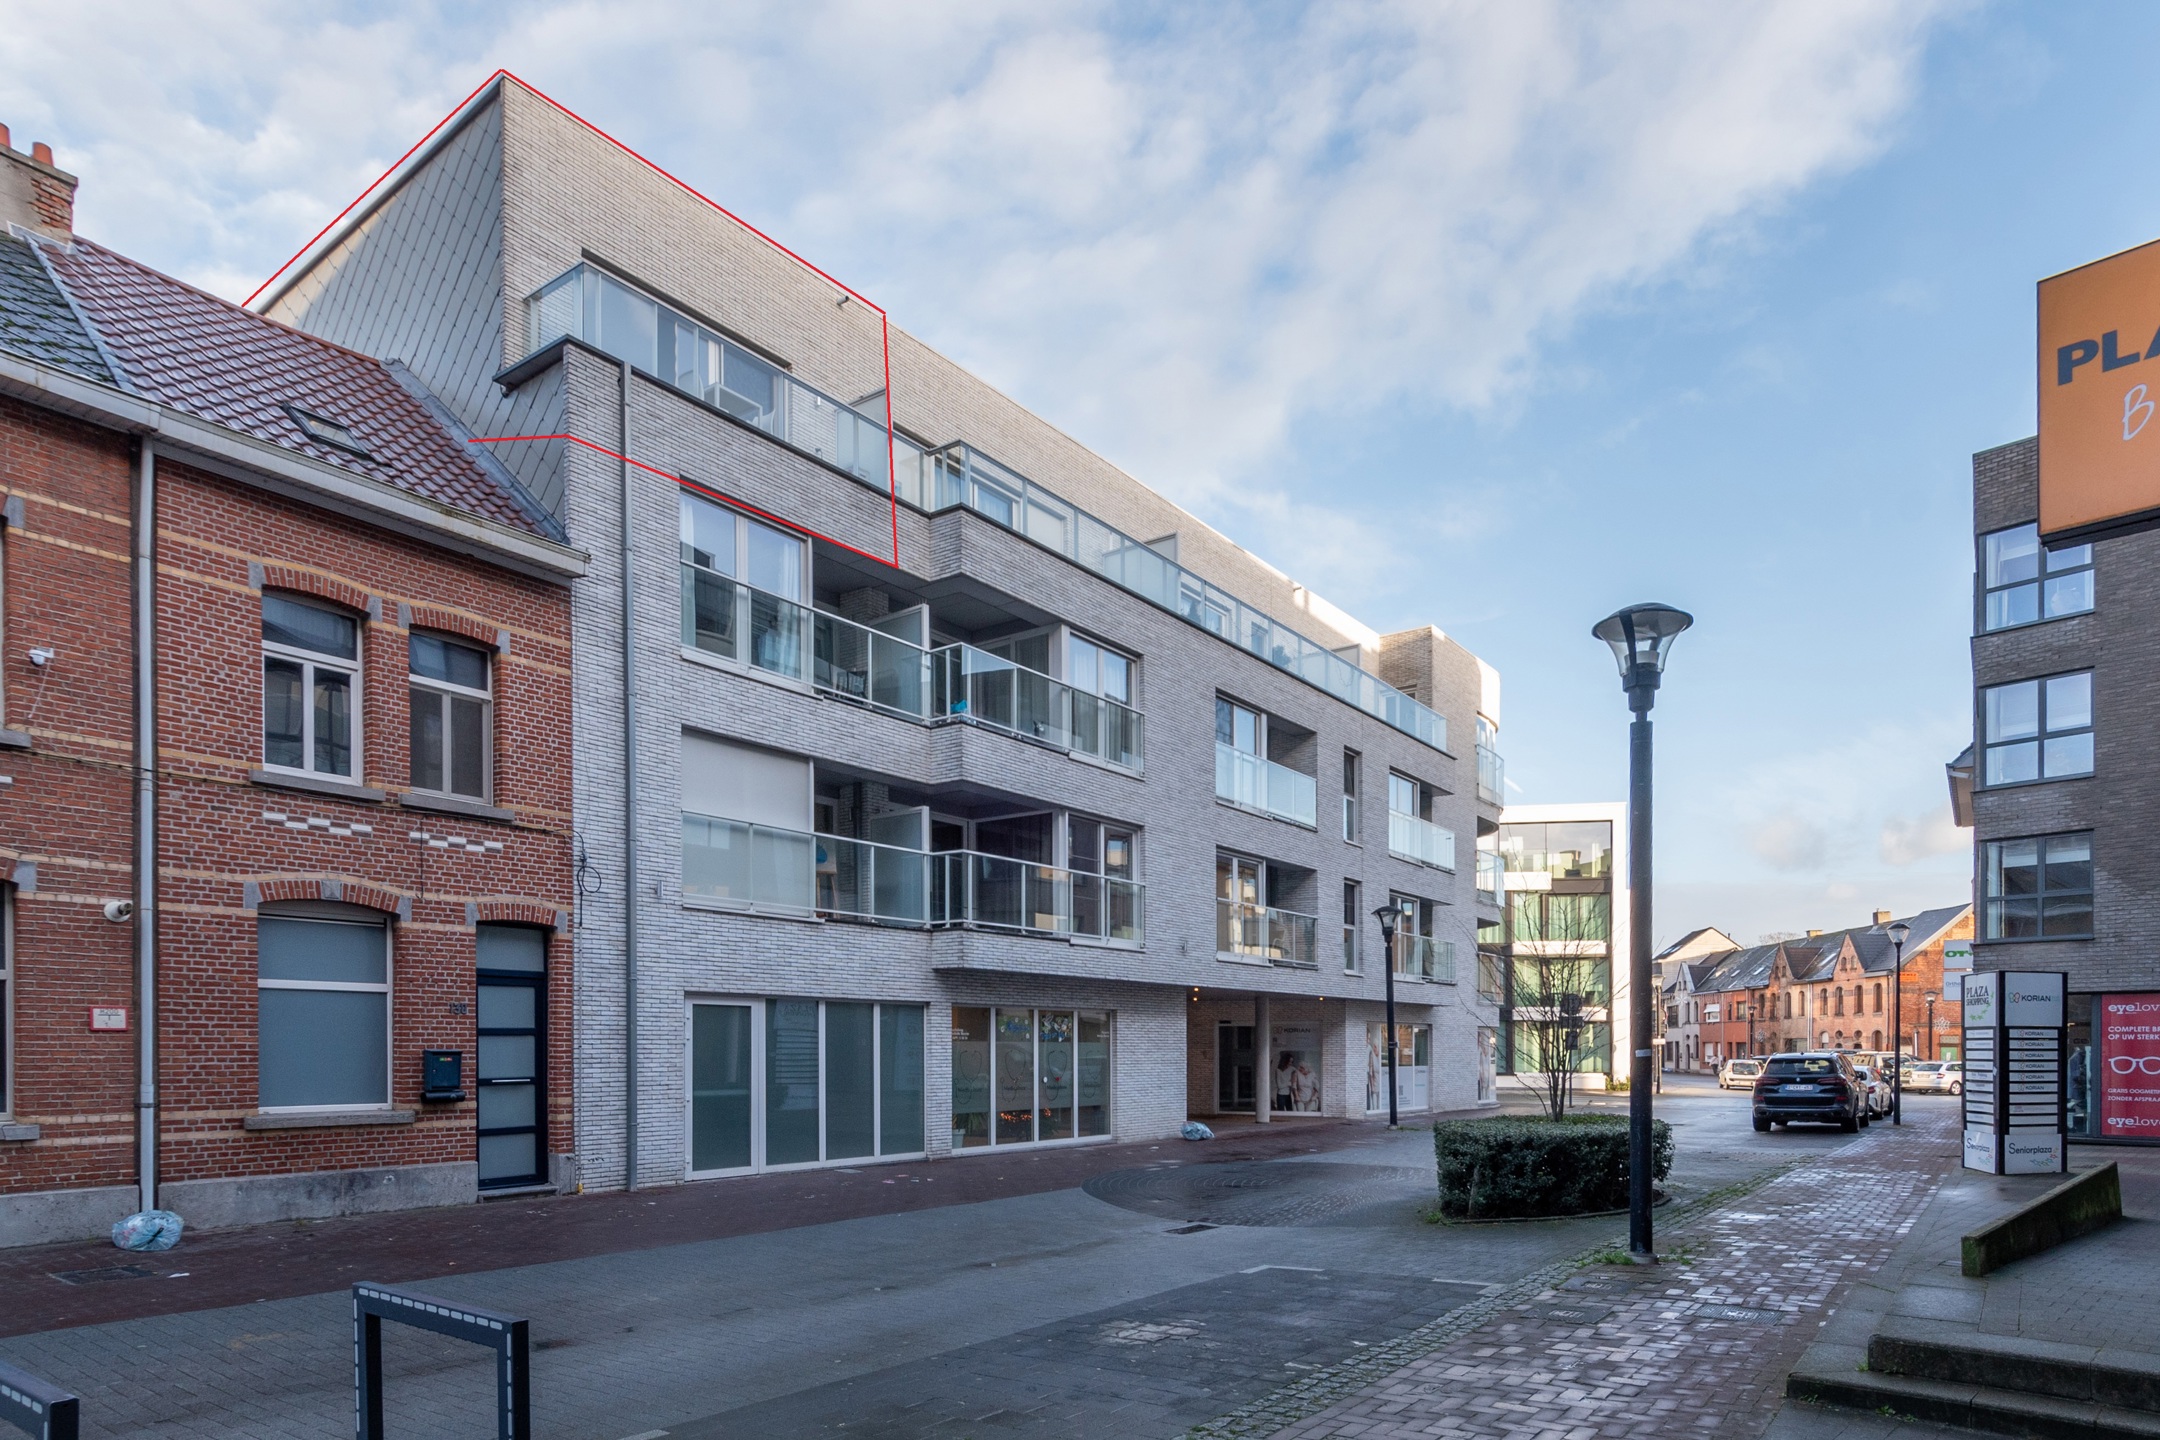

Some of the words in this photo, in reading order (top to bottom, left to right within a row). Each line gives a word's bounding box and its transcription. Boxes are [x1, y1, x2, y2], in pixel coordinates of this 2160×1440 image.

[1966, 986, 1989, 998] PLAZA
[1966, 997, 1990, 1006] SHOPPING
[2021, 994, 2051, 1002] KORIAN
[2108, 1116, 2160, 1127] eyelov
[2008, 1142, 2052, 1155] Seniorplaza
